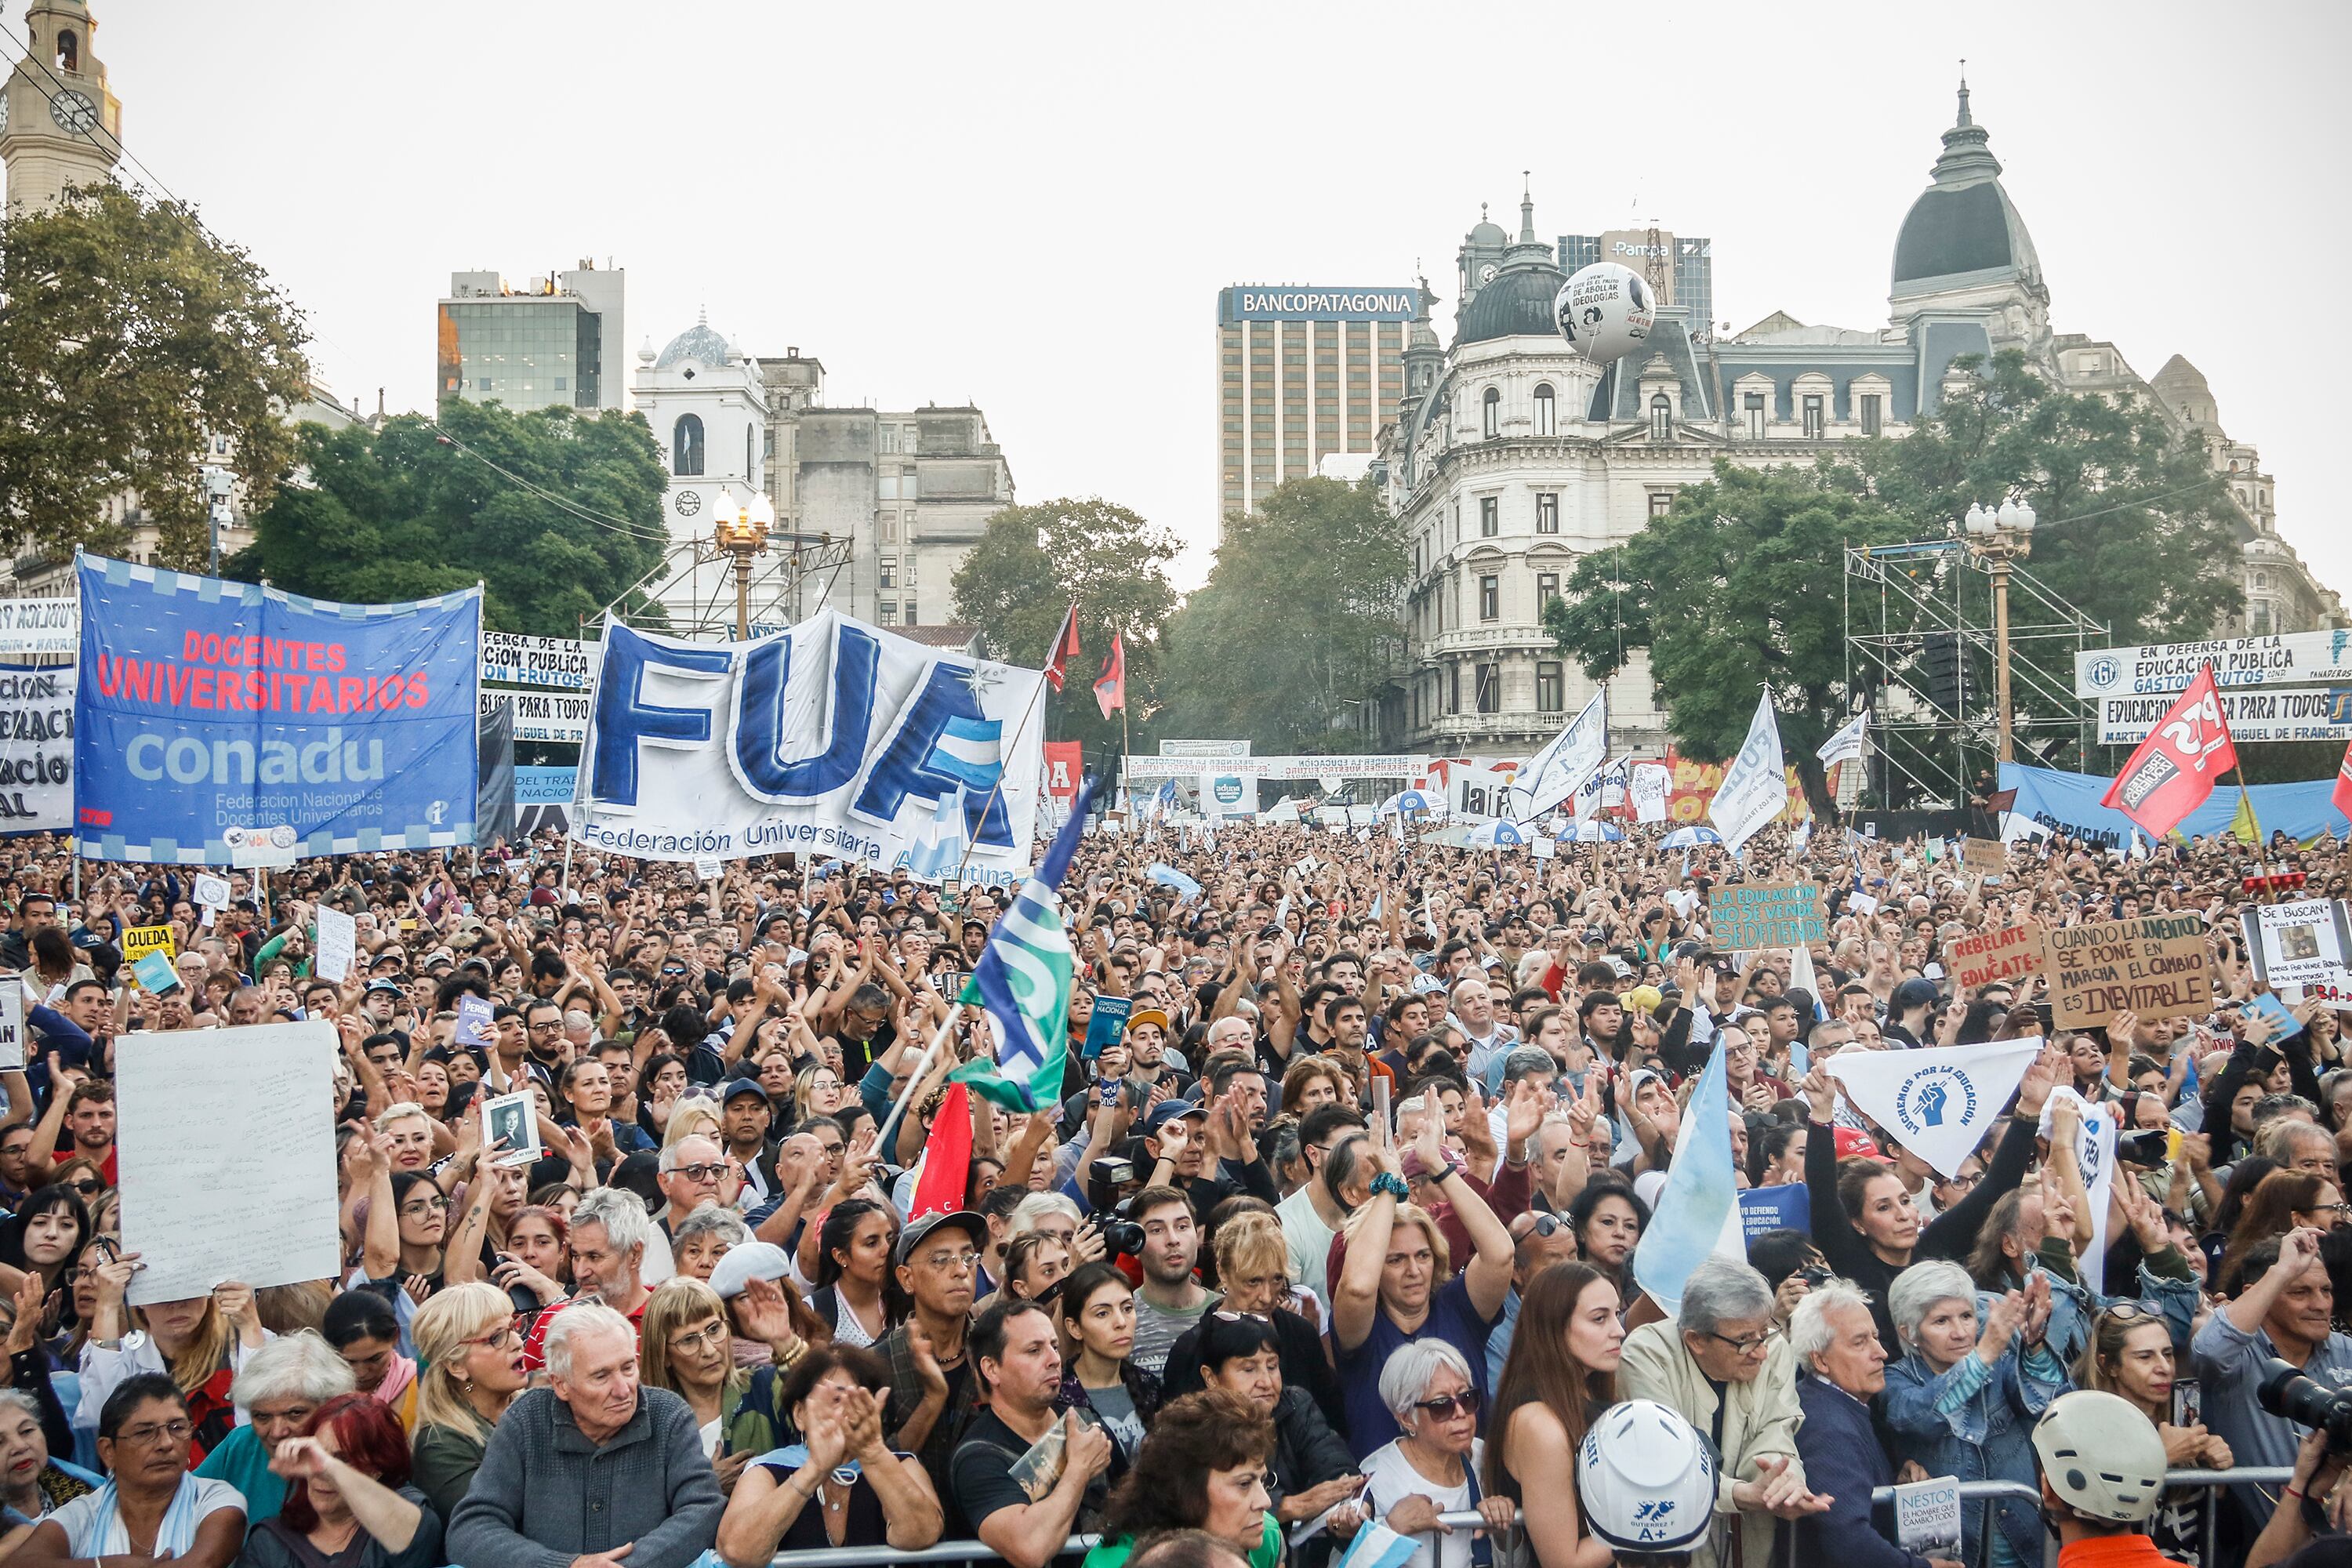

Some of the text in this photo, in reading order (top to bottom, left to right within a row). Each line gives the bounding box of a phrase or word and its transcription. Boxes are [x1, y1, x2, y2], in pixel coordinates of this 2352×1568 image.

[1613, 241, 1668, 259] Pampa
[1585, 285, 1618, 294] ABOLLAR
[1243, 293, 1411, 312] BANCOPATAGONIA
[183, 630, 347, 672] DOCENTES
[539, 638, 556, 650] DE
[564, 641, 582, 653] LA
[2140, 635, 2281, 658] EN DEFENSA DE LA
[98, 654, 429, 714] UNIVERSITARIOS
[517, 668, 583, 687] FRUTOS
[2133, 677, 2194, 694] GASTON
[2215, 670, 2264, 687] RUTOS
[2310, 669, 2352, 679] PANADEROS
[518, 696, 550, 718] PARA
[2239, 695, 2274, 720] PARA
[2281, 693, 2331, 719] TODOS
[554, 729, 566, 739] DE
[591, 625, 1015, 848] FUA
[2275, 728, 2290, 739] DE
[125, 727, 384, 785] conadu
[216, 804, 383, 826] Docentes Univeritarios
[583, 823, 1014, 885] Federación Universitaria Aentina
[1710, 881, 1817, 906] LA EDUCACIÓN
[1712, 906, 1740, 923] NO
[1741, 904, 1760, 923] SE
[128, 929, 170, 947] QUEDA
[1714, 920, 1826, 949] SE DEFIENDE
[2122, 923, 2139, 940] LA
[2141, 915, 2203, 940] JUVENTUD
[1955, 926, 2027, 958] REBELATE
[1987, 953, 1997, 965] &
[2057, 941, 2163, 969] SE PONE EN
[1960, 953, 2033, 988] EDUCATE
[2060, 964, 2119, 989] MARCHA
[2128, 960, 2149, 980] EL
[1098, 1000, 1129, 1009] CONSTITUCIÓN
[2062, 977, 2205, 1015] ES INEVITABLE
[465, 1003, 490, 1016] PERÓN
[1097, 1006, 1127, 1015] NACIONAL
[1897, 1078, 1920, 1135] LUCHEMOS
[1914, 1065, 1936, 1079] POR
[1952, 1069, 1976, 1127] EDUCACIÓN
[1746, 1216, 1781, 1225] EDUCACIÓN
[1749, 1206, 1779, 1214] DEFIENDO
[1902, 1488, 1955, 1510] NÉSTOR
[1911, 1507, 1940, 1517] HOMBRE
[1941, 1503, 1955, 1512] QUE
[1935, 1511, 1955, 1521] TODO
[1638, 1528, 1667, 1541] A+
